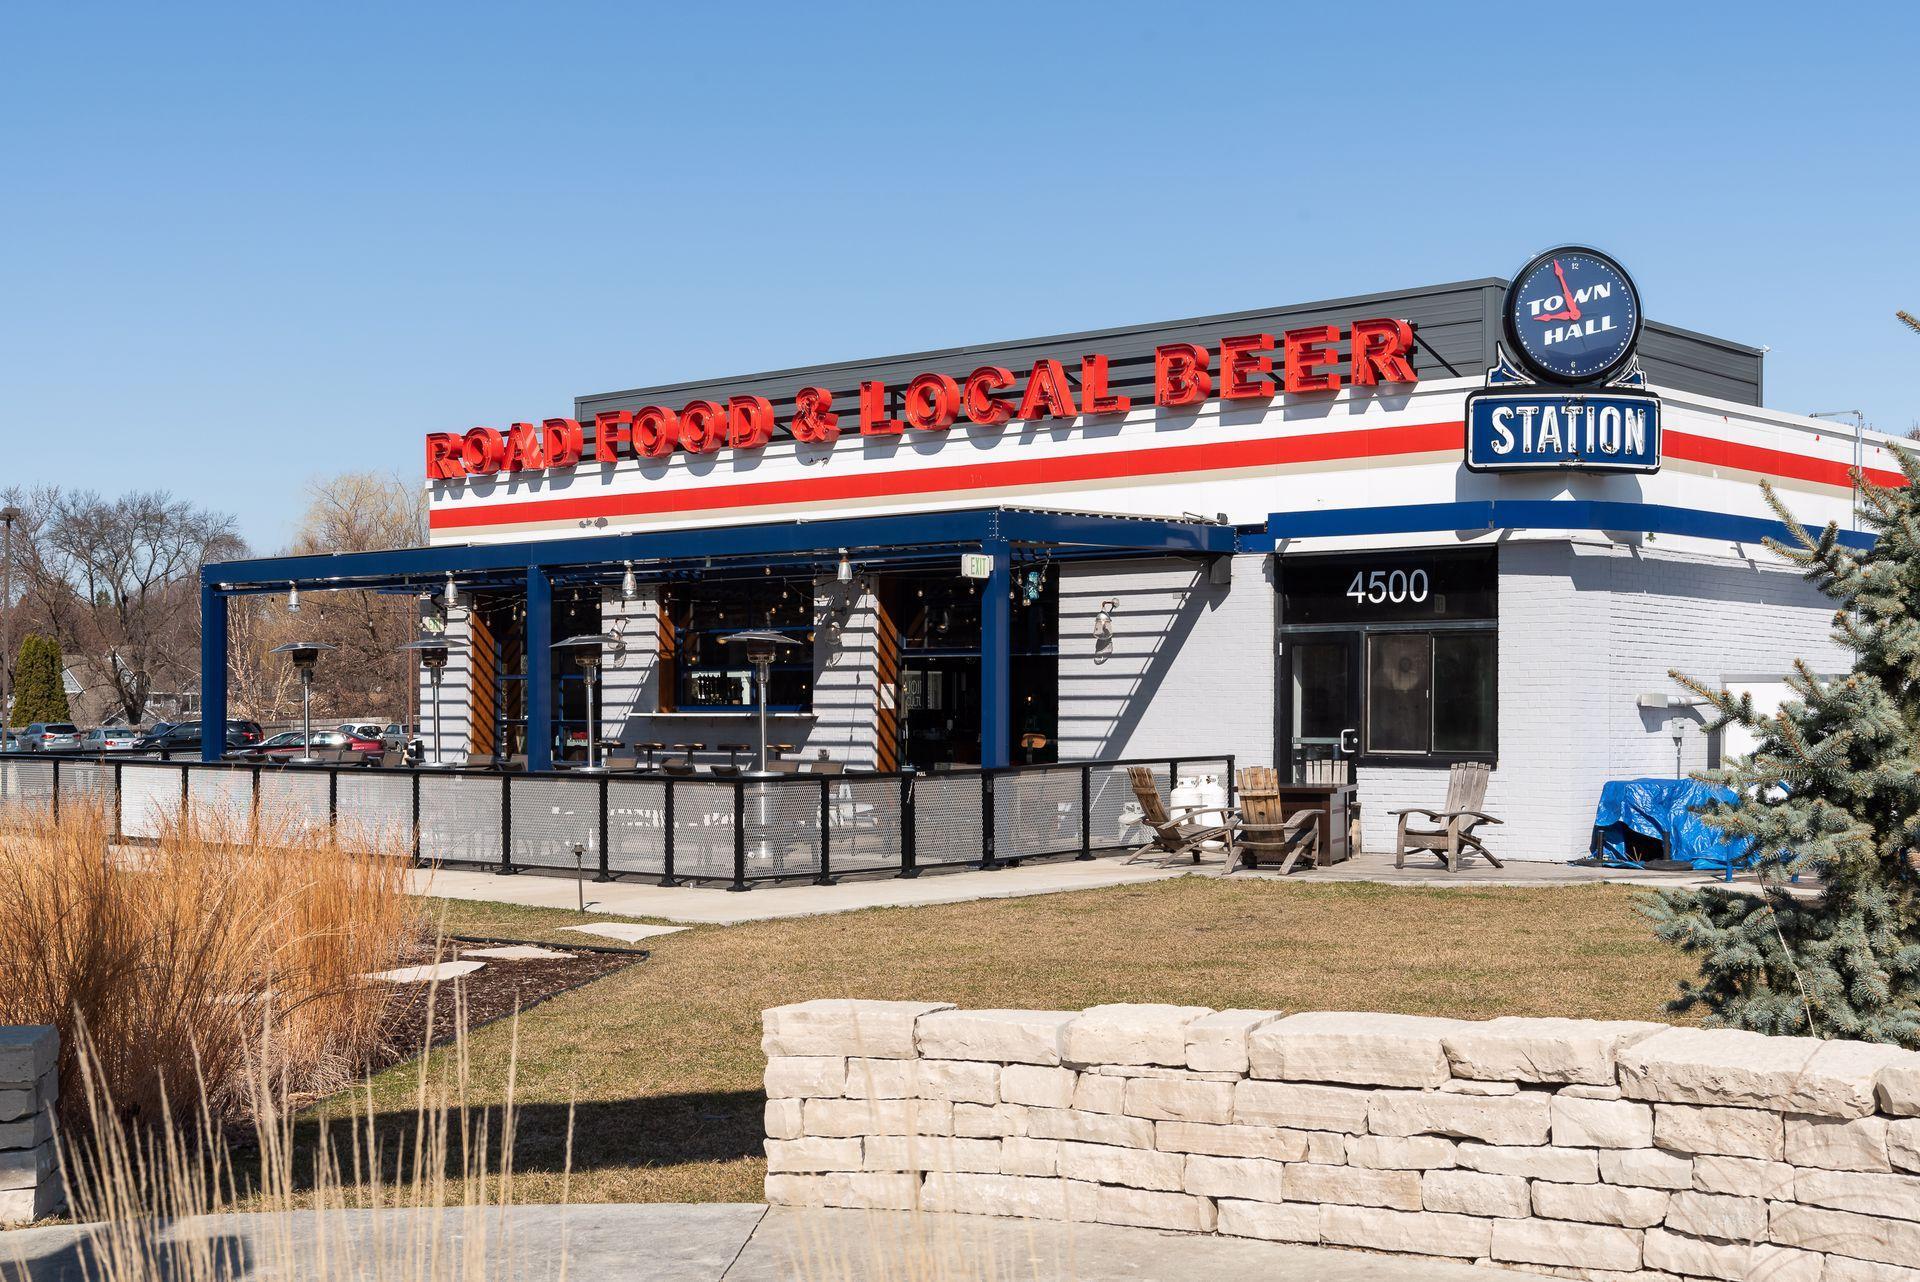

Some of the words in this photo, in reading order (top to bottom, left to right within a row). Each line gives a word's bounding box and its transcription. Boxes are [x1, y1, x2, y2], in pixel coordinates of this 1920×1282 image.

[1571, 262, 1579, 270] 12
[1527, 282, 1611, 316] TOWN
[1544, 315, 1618, 346] HALL
[425, 417, 584, 480] ROAD
[595, 395, 774, 463] FOOD
[792, 387, 842, 444] &
[859, 353, 1131, 437] LOCAL
[1154, 317, 1419, 407] BEER
[1491, 405, 1646, 456] STATION
[970, 556, 987, 576] EXIT
[1346, 568, 1429, 604] 4500
